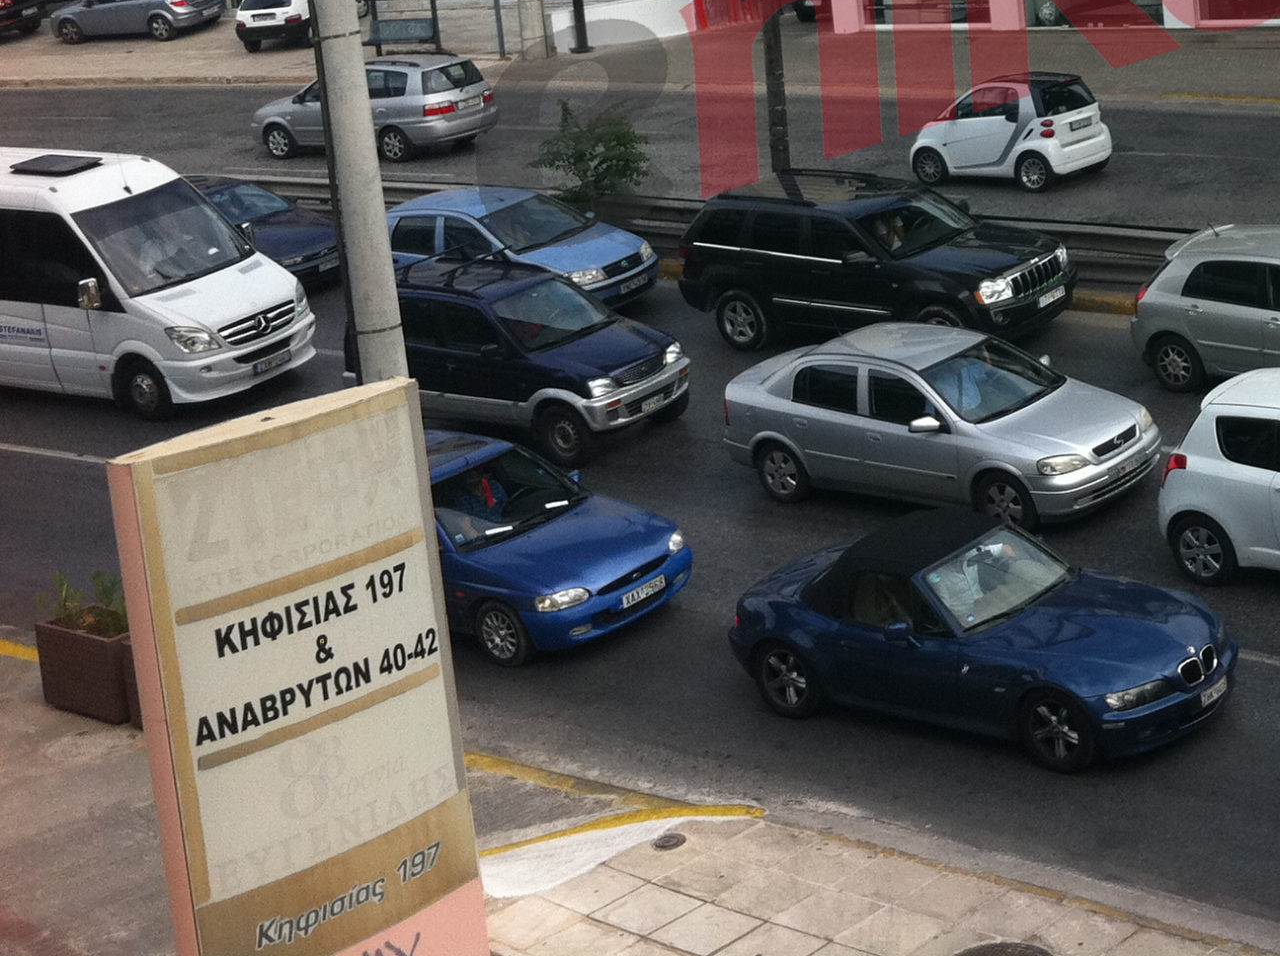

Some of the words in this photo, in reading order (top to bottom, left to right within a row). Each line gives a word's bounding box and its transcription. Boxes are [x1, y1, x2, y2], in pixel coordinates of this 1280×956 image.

[214, 582, 358, 658] ΚΗΦΙΣΙΑΣ
[365, 562, 407, 604] 197
[315, 634, 335, 664] &
[196, 657, 372, 746] ΑΝΑΒΡΥΤΩΝ
[379, 627, 439, 675] 40-42
[256, 877, 386, 950] Κηφισίας
[396, 840, 442, 884] 197
